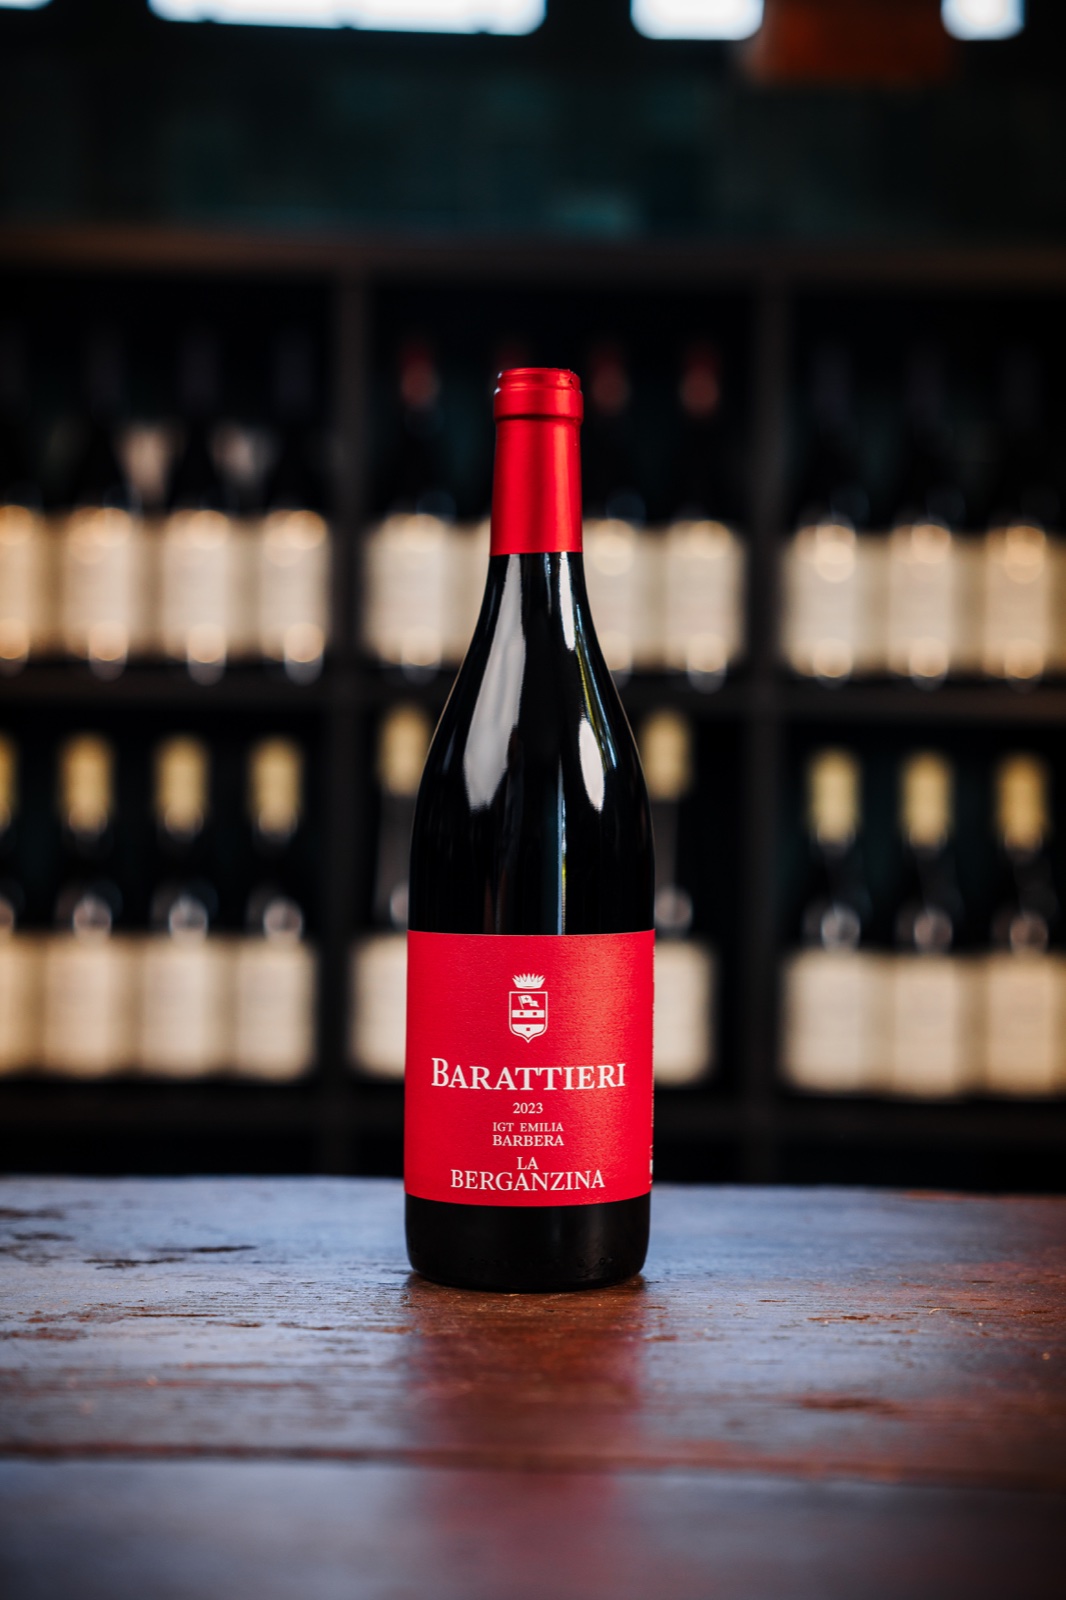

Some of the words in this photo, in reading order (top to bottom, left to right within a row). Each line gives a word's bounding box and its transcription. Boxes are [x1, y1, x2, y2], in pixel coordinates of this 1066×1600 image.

[431, 1057, 626, 1091] BARATTIERI
[512, 1102, 544, 1114] 2023
[492, 1122, 514, 1132] IGT
[519, 1122, 564, 1132] EMILIA
[492, 1134, 565, 1147] BARBERA
[516, 1156, 539, 1170] LA
[450, 1169, 606, 1191] BERGANZINA
